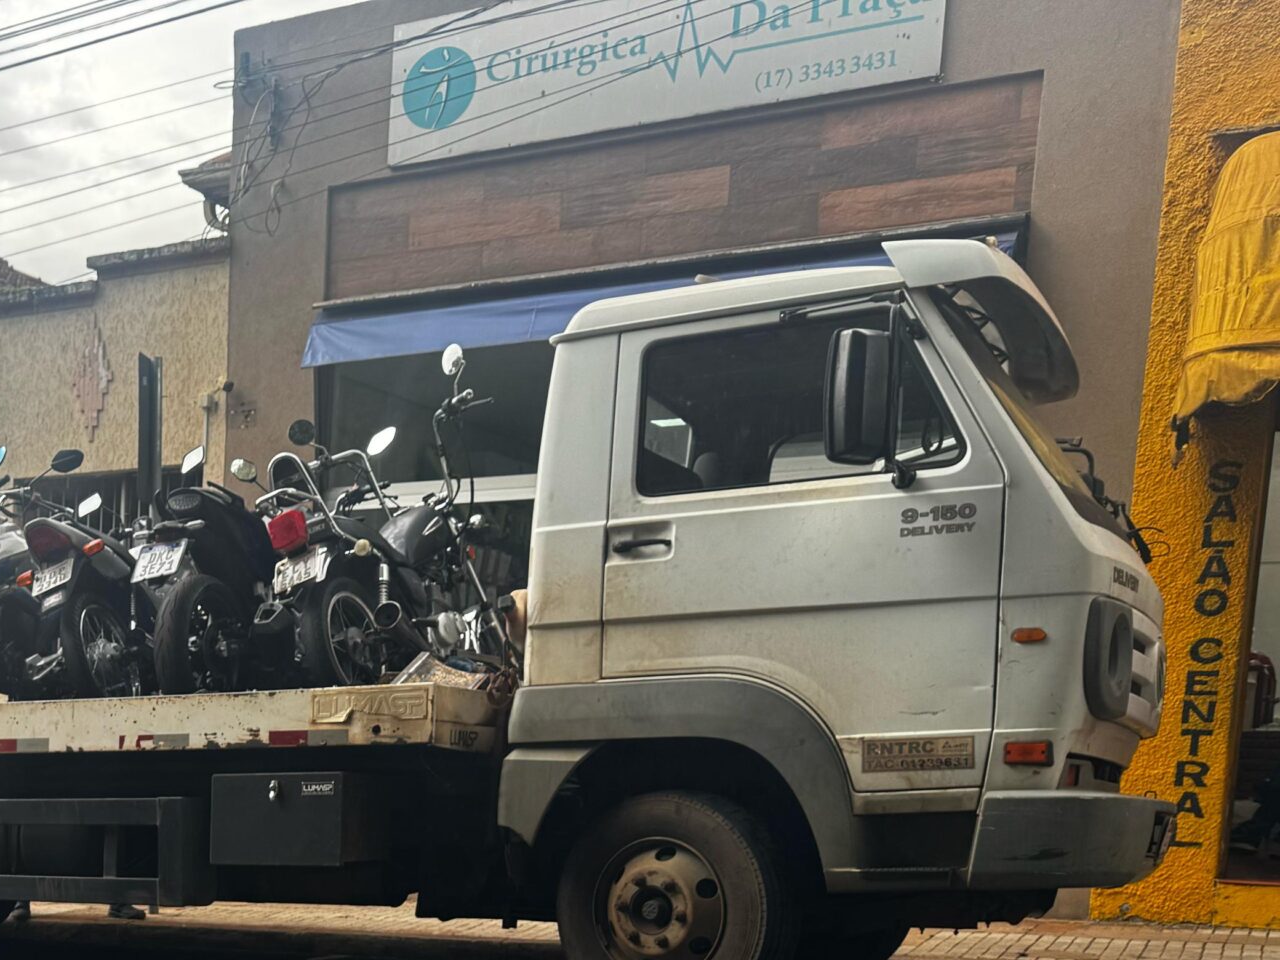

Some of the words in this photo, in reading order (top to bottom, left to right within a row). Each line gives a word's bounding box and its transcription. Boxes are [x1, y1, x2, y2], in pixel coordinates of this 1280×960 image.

[486, 31, 647, 83] Cirúrgica
[729, 0, 791, 39] Da
[754, 67, 793, 93] (17)
[798, 58, 846, 83] 3343
[849, 49, 898, 72] 3431
[900, 502, 977, 525] 9-150
[900, 522, 976, 537] DELIVERY
[1113, 566, 1139, 593] DELIVERY
[866, 741, 935, 755] RNTRC
[302, 784, 333, 792] LUMASP
